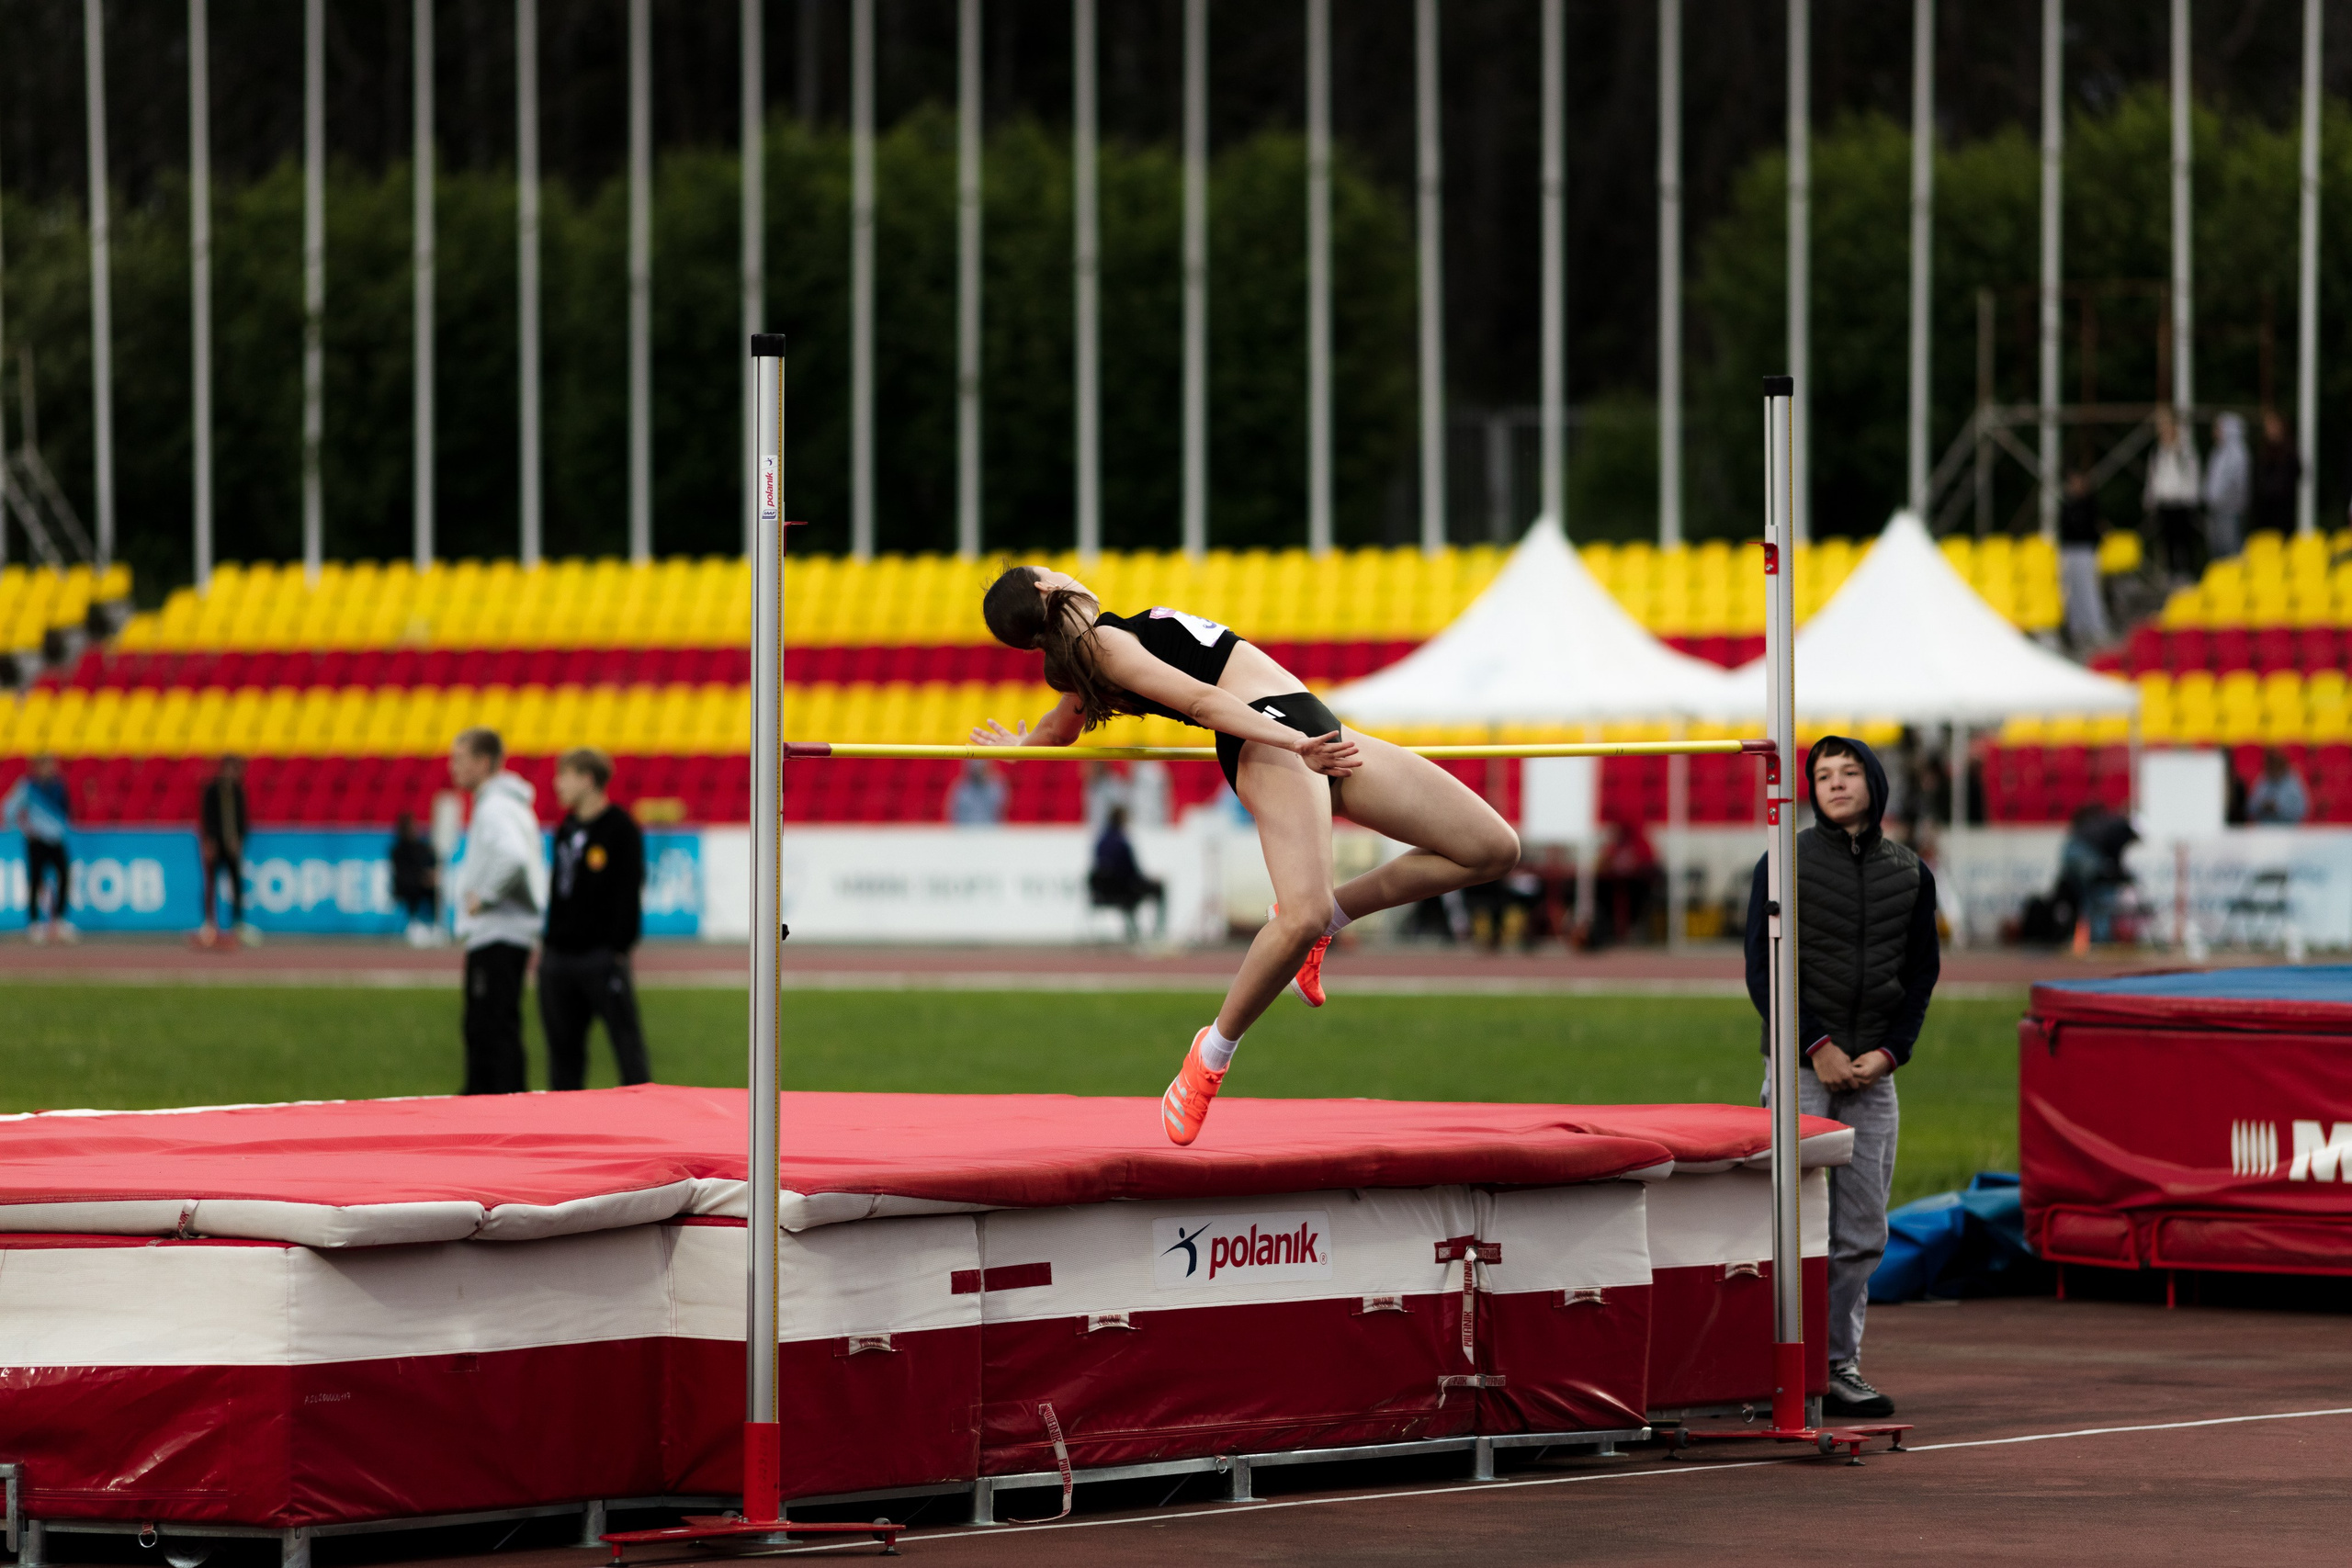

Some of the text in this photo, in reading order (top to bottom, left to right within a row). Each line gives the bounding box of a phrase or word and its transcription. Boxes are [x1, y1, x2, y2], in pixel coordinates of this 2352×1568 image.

[765, 472, 775, 507] polanik
[1209, 1221, 1318, 1280] polanik
[1463, 1311, 1473, 1348] POLANIK
[1058, 1458, 1071, 1495] POLANIK
